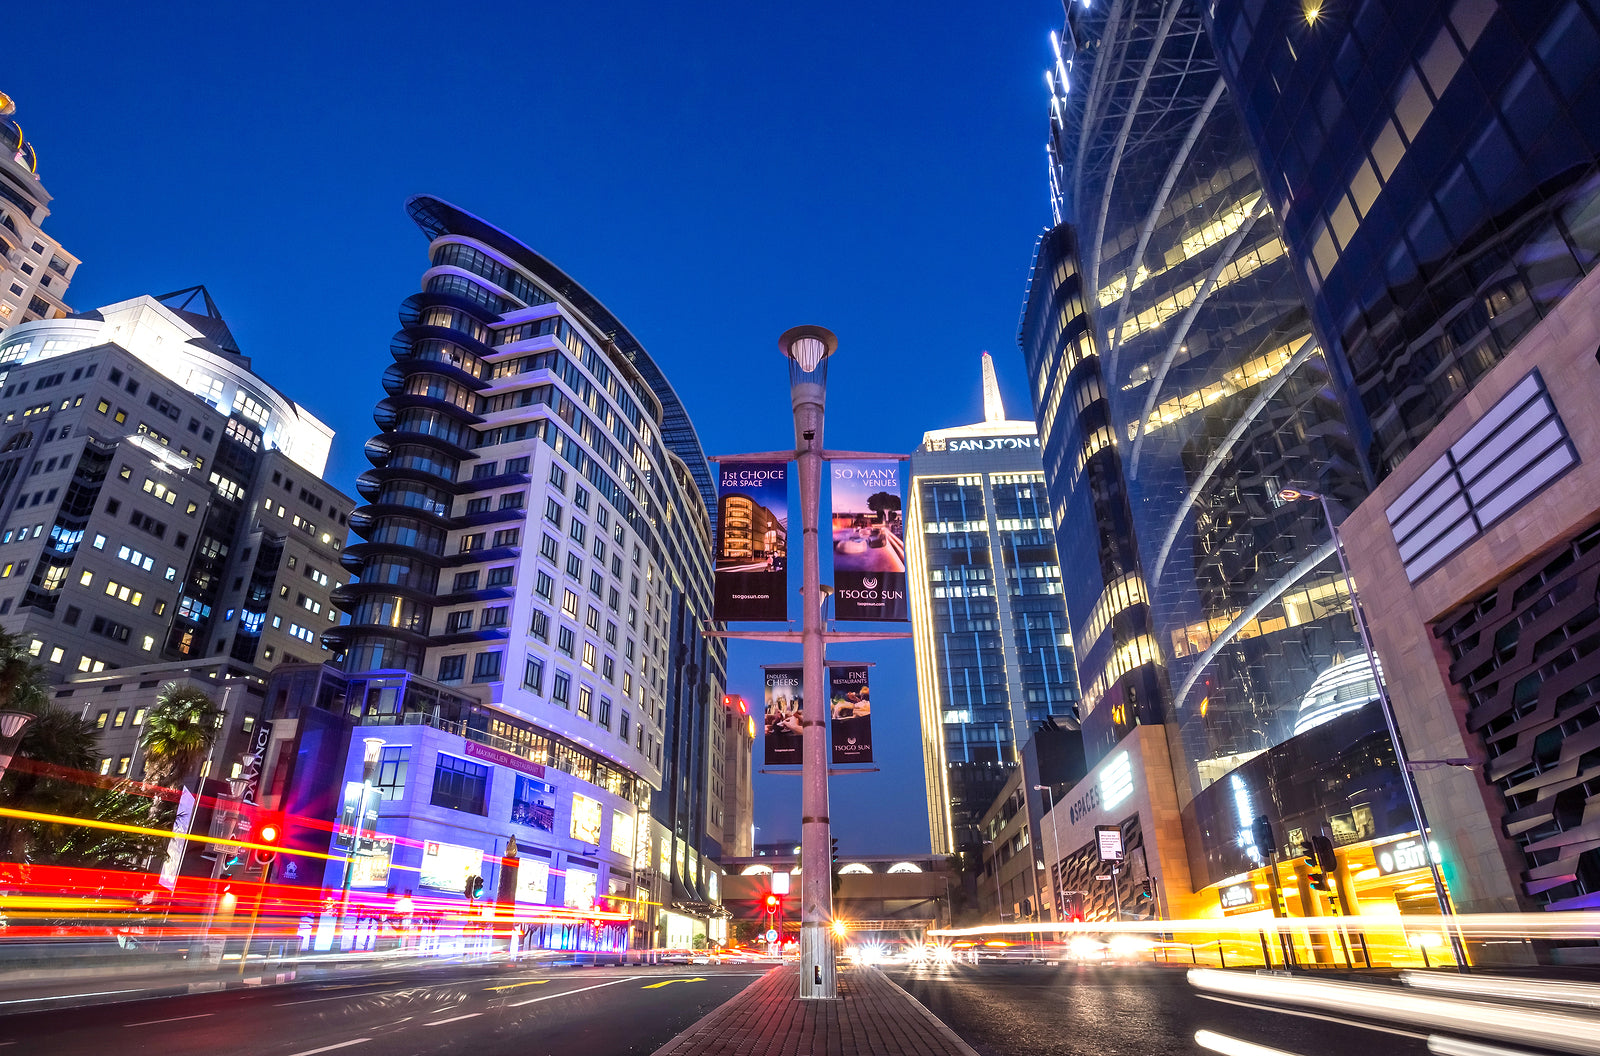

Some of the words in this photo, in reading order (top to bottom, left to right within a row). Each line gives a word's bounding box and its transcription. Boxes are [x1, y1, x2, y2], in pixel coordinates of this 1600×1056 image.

[723, 471, 737, 480] 1st
[740, 470, 784, 480] CHOICE
[835, 469, 853, 478] SO
[857, 469, 897, 479] MANY
[863, 479, 897, 487] VENUES
[839, 590, 878, 599] TSOGO
[881, 590, 903, 600] SUN
[848, 671, 867, 679] FINE
[766, 679, 799, 687] CHEERS
[510, 758, 539, 773] RESTAURANT
[1074, 784, 1100, 822] SPACES
